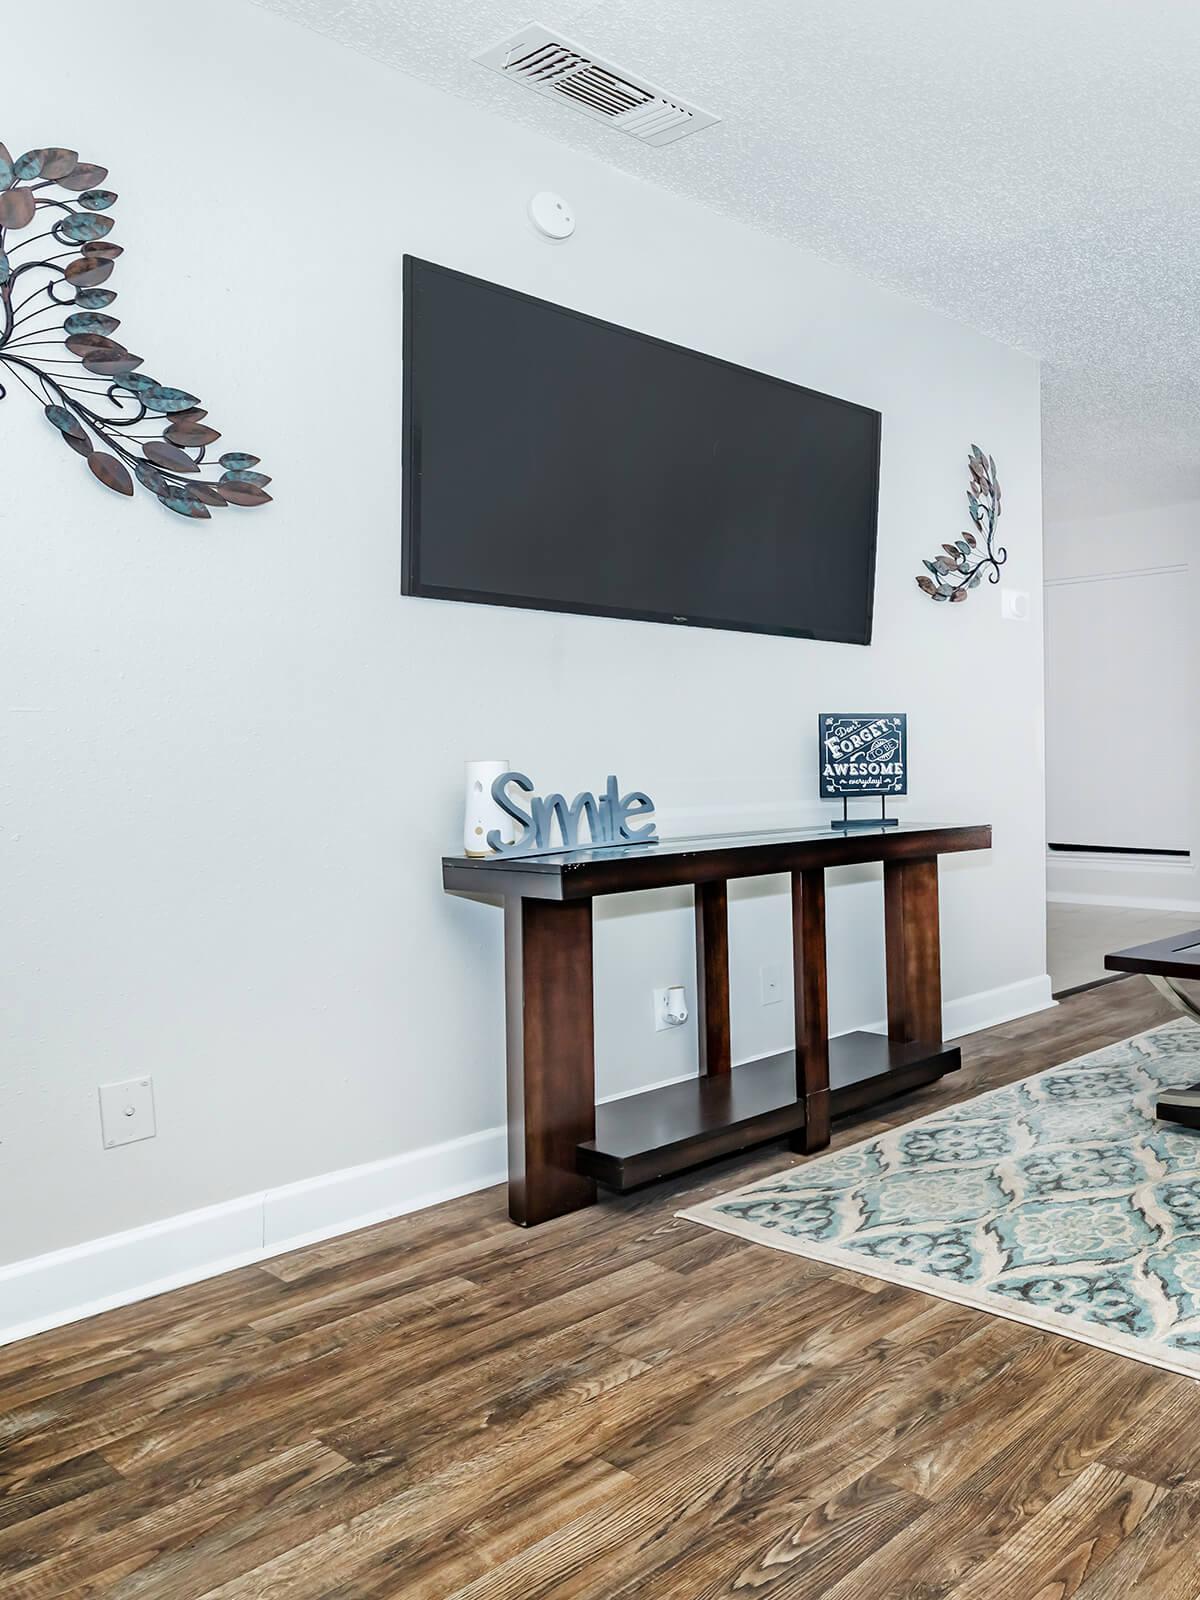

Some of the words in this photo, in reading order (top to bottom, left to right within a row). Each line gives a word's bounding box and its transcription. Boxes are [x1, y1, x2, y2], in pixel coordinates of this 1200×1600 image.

[824, 719, 889, 759] FORGET
[870, 749, 883, 759] TO
[884, 742, 895, 752] BE
[823, 763, 903, 776] AWESOME
[848, 776, 882, 787] everyday!
[487, 772, 657, 855] Smile
